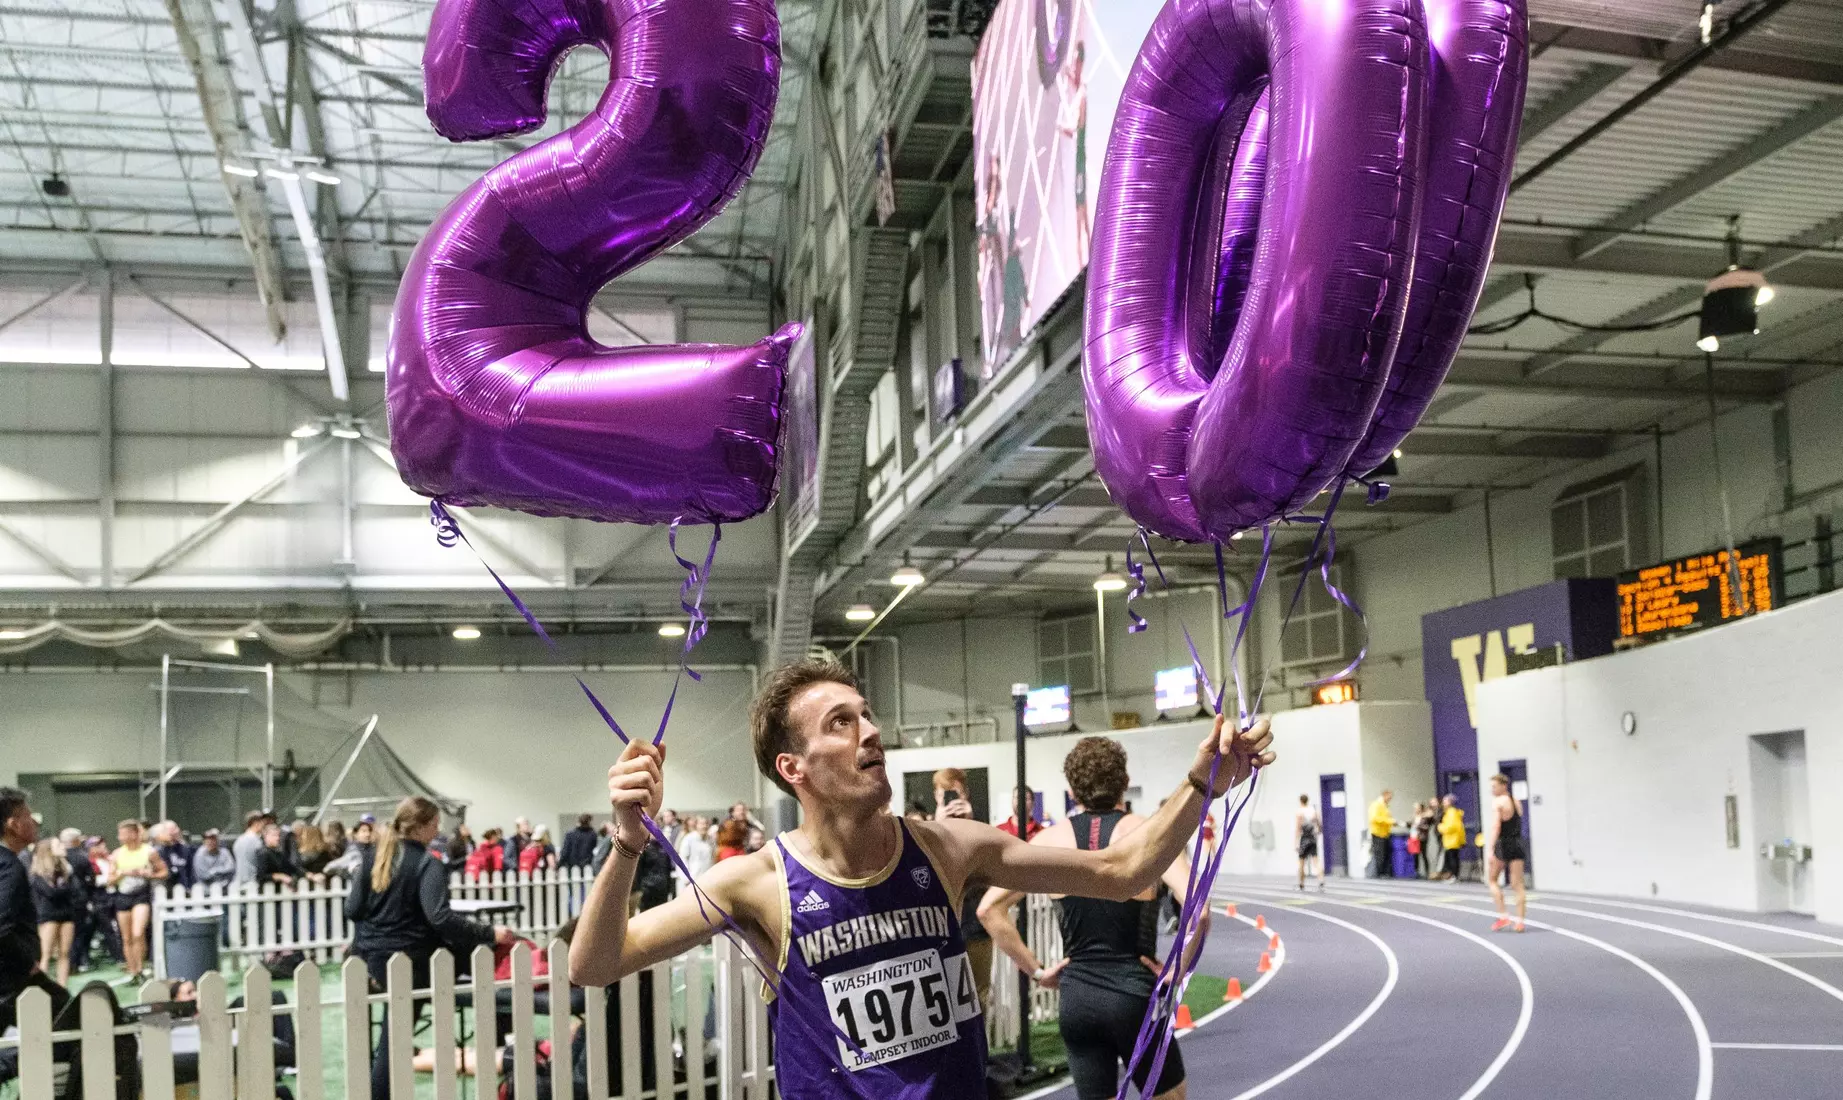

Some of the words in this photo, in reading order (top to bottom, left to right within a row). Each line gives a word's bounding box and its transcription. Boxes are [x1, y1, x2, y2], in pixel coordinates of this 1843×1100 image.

[797, 901, 830, 913] adidas
[797, 906, 951, 968] WASHINGTON
[832, 956, 933, 994] WASHINGTON
[957, 957, 976, 1014] 4
[836, 972, 951, 1052] 1975
[910, 1030, 951, 1051] INDOOR
